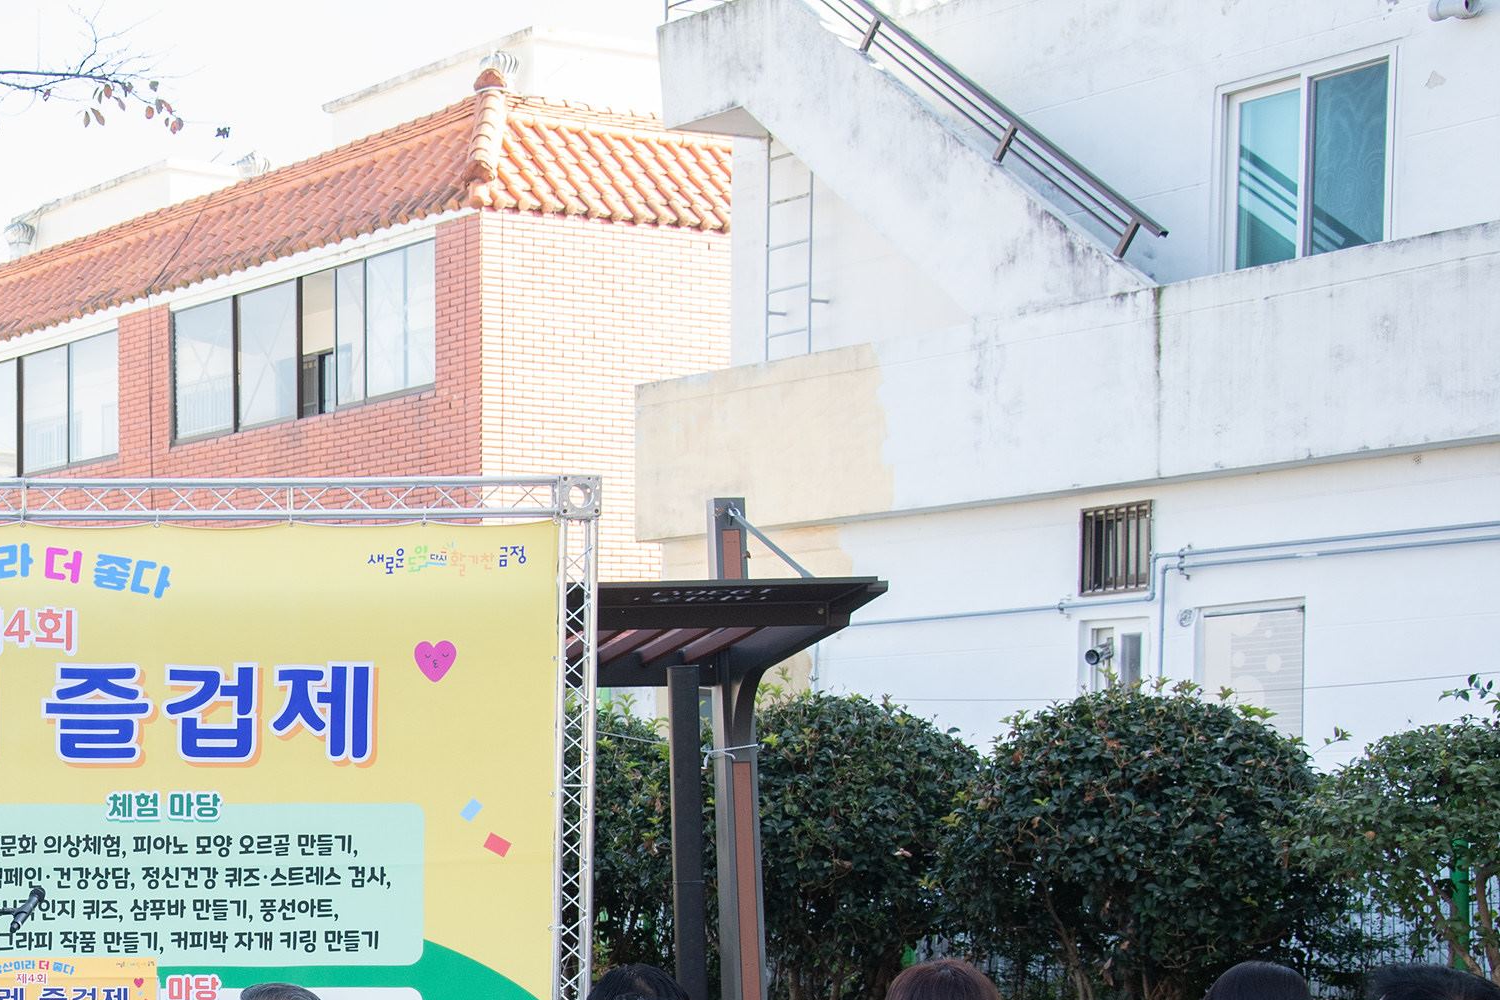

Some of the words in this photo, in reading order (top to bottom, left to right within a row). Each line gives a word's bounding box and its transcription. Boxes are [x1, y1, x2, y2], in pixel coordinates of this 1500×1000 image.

[367, 548, 405, 574] 새로운
[430, 553, 447, 562] 다시
[499, 545, 527, 568] 금정
[44, 547, 83, 585] 더
[93, 552, 171, 599] 좋다
[42, 662, 376, 763] 즐겁제
[107, 793, 161, 821] 체험
[168, 791, 221, 820] 마당
[43, 834, 127, 857] 의상체험,
[133, 833, 189, 855] 피아노
[195, 833, 232, 856] 모양
[239, 833, 290, 856] 오르골
[297, 833, 359, 857] 만들기,
[141, 866, 218, 890] 정신건강
[225, 865, 341, 889] 퀴즈·스트레스
[350, 865, 391, 889] 검사,
[2, 899, 76, 922] 인지
[82, 899, 124, 922] 퀴즈,
[130, 899, 186, 921] 샴푸바
[193, 899, 254, 922] 만들기,
[260, 897, 339, 921] 풍선아트,
[60, 930, 97, 954] 작품
[103, 930, 164, 955] 만들기,
[170, 931, 229, 953] 커피박
[234, 930, 273, 952] 자개
[280, 929, 318, 953] 키링
[324, 929, 380, 953] 만들기
[39, 960, 50, 970] 더
[16, 974, 47, 984] 제4회
